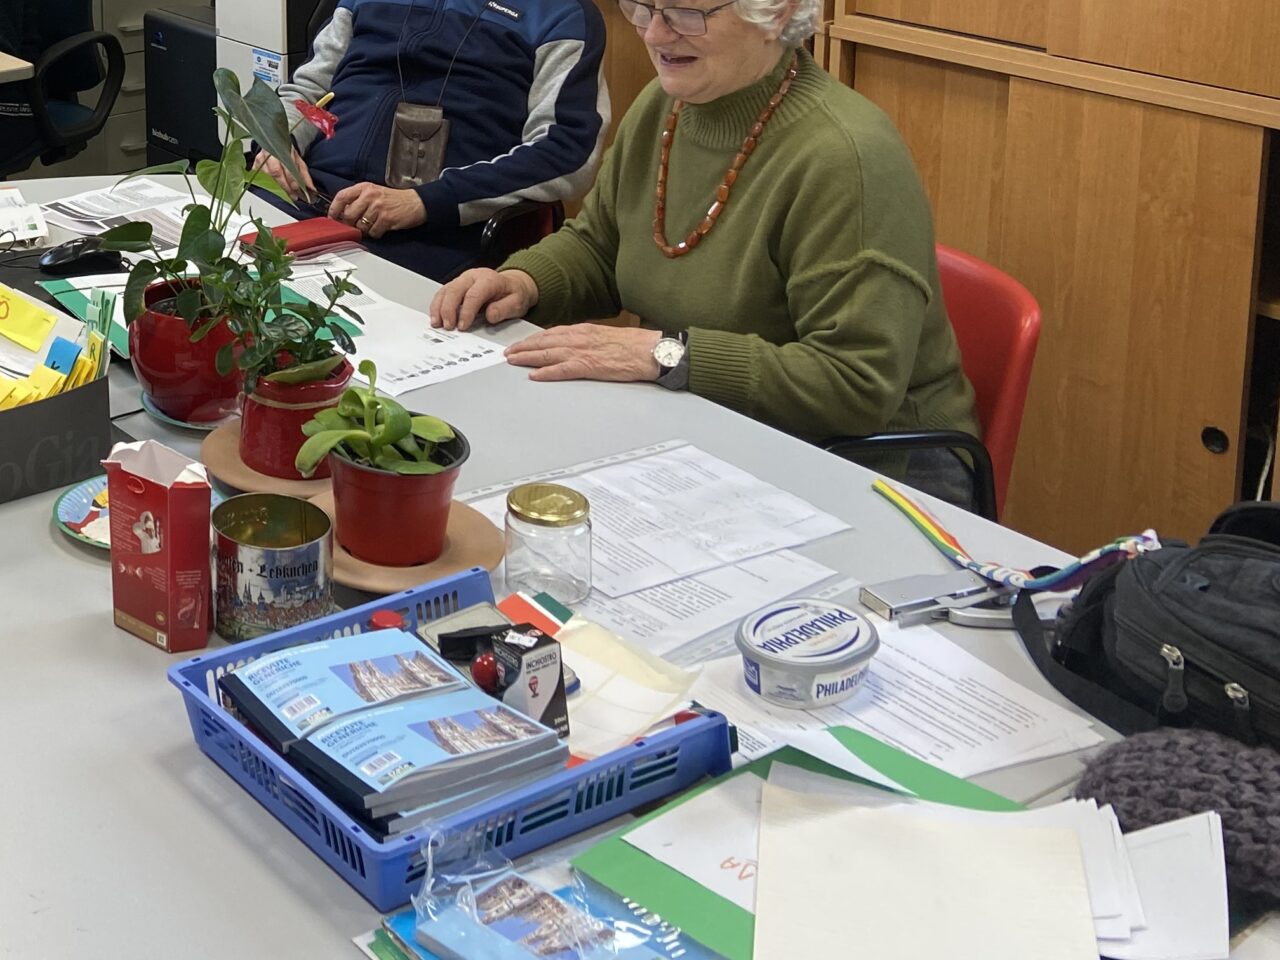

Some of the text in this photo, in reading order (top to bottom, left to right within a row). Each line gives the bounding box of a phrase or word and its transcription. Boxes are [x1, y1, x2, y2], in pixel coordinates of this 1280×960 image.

[89, 342, 96, 361] R
[756, 608, 857, 653] PHILADELPHIA
[248, 658, 289, 681] RICEVUTE
[253, 660, 302, 685] GENERICHE
[526, 652, 556, 669] INCHIOSTRO
[321, 720, 364, 744] RICEVUTE
[327, 722, 378, 748] GENERICHE
